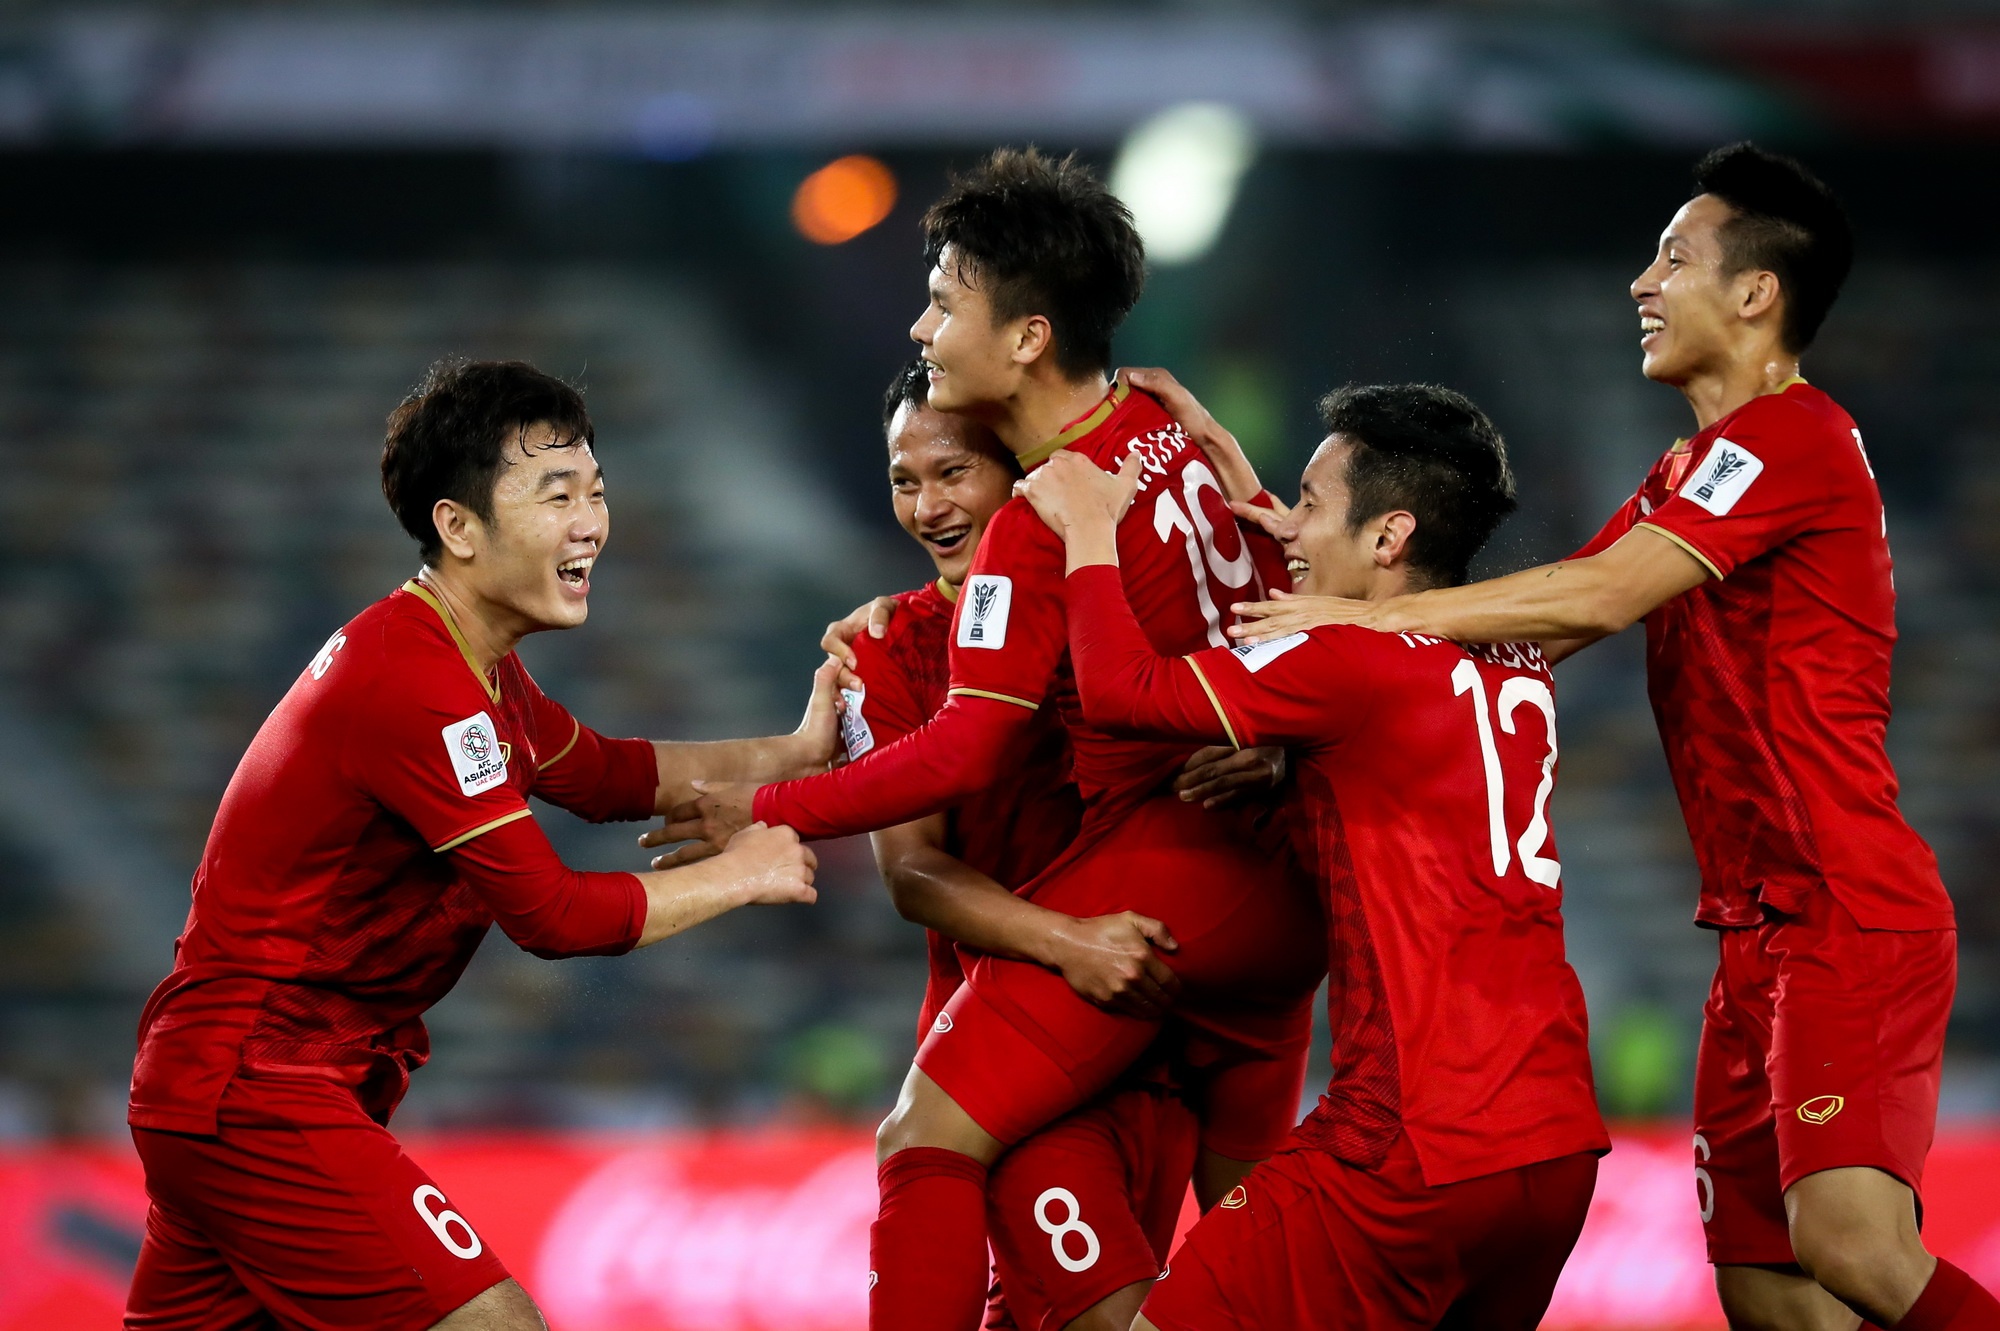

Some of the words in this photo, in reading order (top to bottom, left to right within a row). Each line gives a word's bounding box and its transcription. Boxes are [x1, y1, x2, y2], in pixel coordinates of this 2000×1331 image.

[1153, 459, 1268, 650] 19
[464, 768, 490, 784] ASIAN
[491, 761, 503, 773] CUP
[475, 778, 488, 786] UAE
[478, 760, 491, 770] AFC
[1451, 658, 1561, 890] 12
[412, 1184, 482, 1260] 6
[1034, 1187, 1100, 1272] 8
